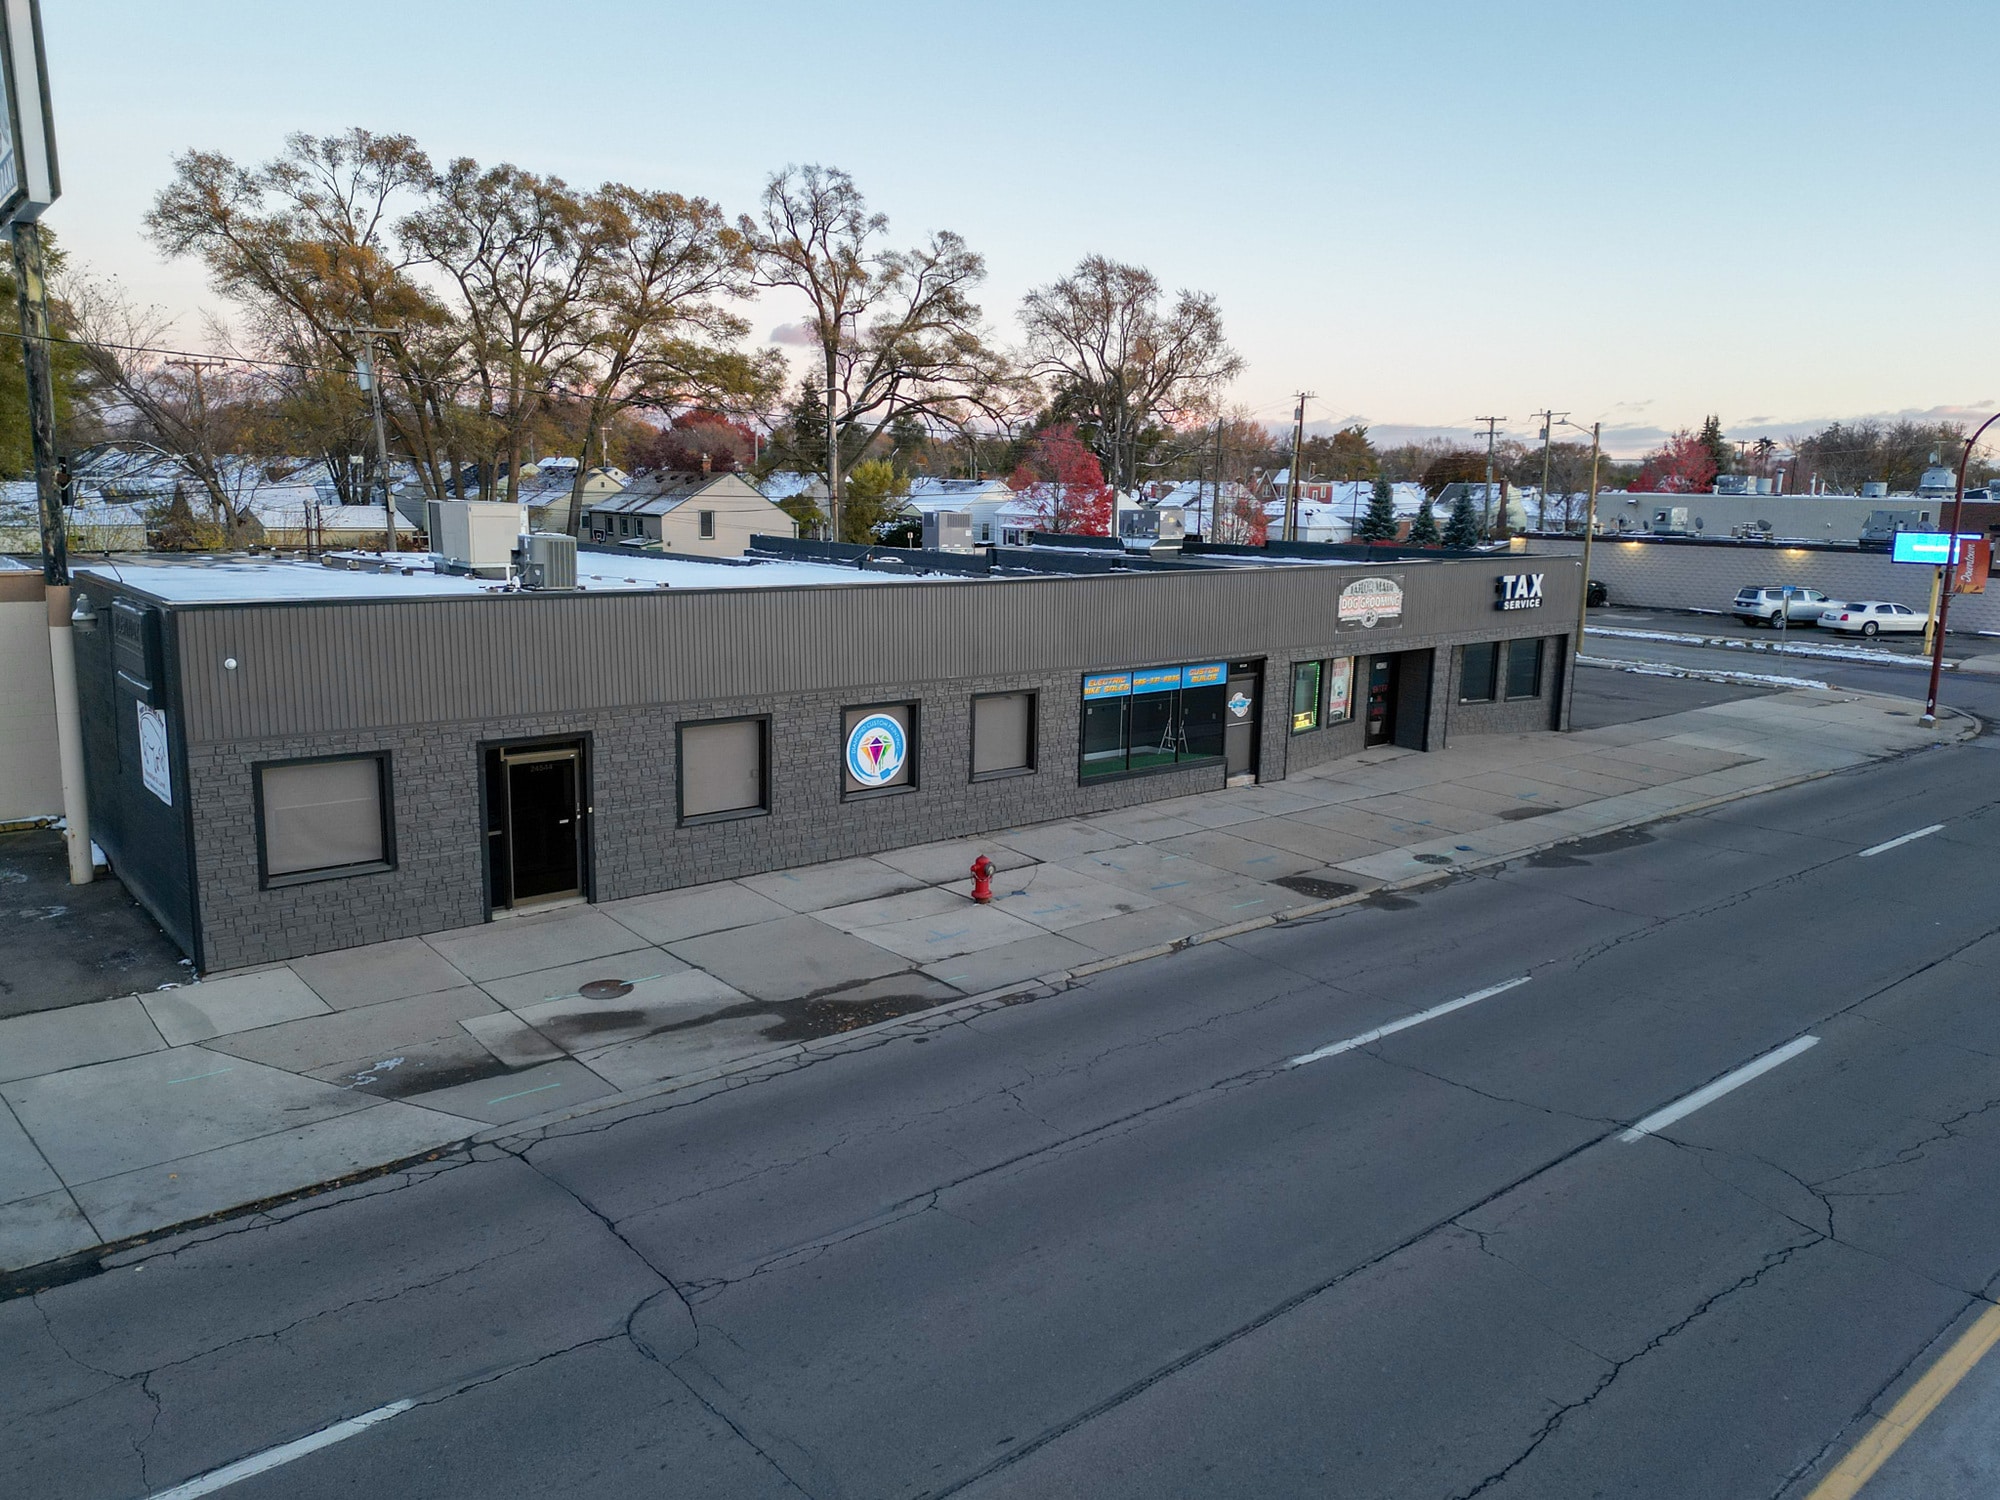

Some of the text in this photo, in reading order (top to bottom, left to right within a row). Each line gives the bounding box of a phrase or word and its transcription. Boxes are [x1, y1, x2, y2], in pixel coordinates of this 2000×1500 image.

[1961, 543, 1976, 582] Downtown
[1503, 573, 1544, 599] TAX
[1342, 595, 1400, 609] DOG GROOMING
[1504, 598, 1541, 610] SERVICE
[1189, 667, 1220, 676] CUSTOM
[1088, 676, 1127, 687] ELECTRIC
[1104, 684, 1130, 693] SALES
[851, 726, 866, 754] DIAMOND
[866, 720, 888, 728] CUSTOM
